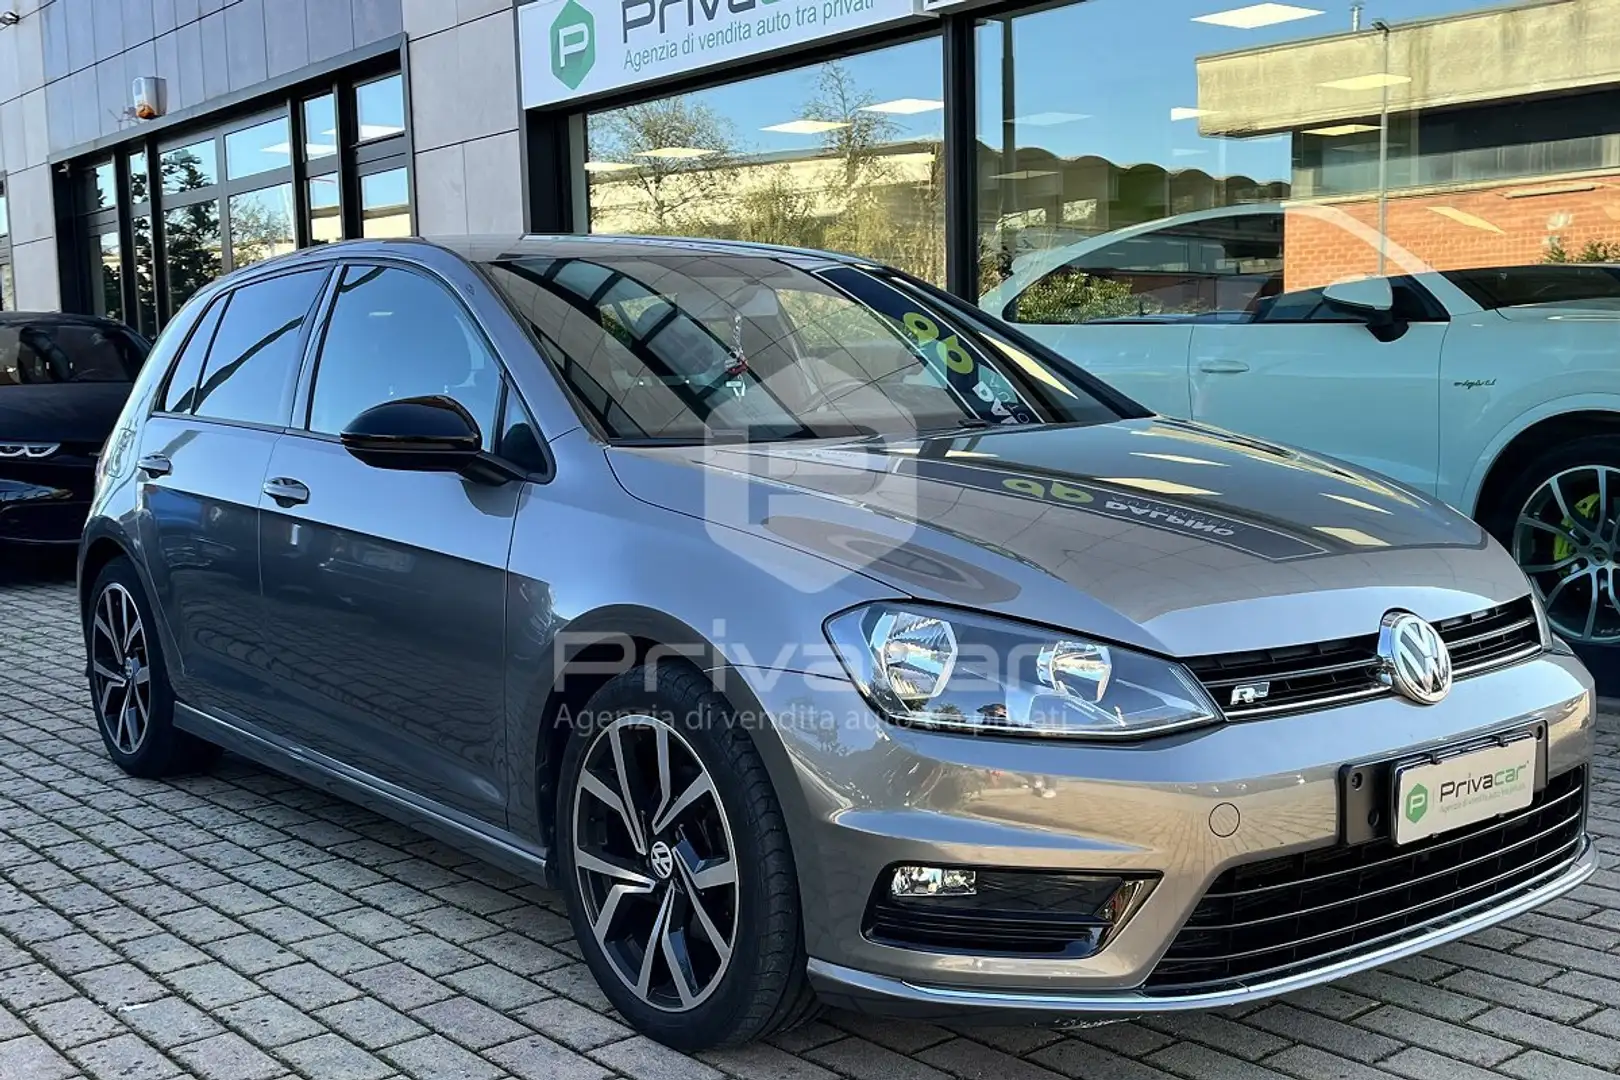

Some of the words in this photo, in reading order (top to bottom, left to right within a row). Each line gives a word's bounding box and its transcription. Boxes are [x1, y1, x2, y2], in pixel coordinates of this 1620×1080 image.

[558, 23, 589, 68] P
[624, 41, 678, 72] Agenzia
[682, 33, 694, 55] di
[699, 21, 751, 51] vendita
[757, 13, 791, 37] auto
[796, 6, 817, 26] tra
[1439, 764, 1527, 802] Privacar
